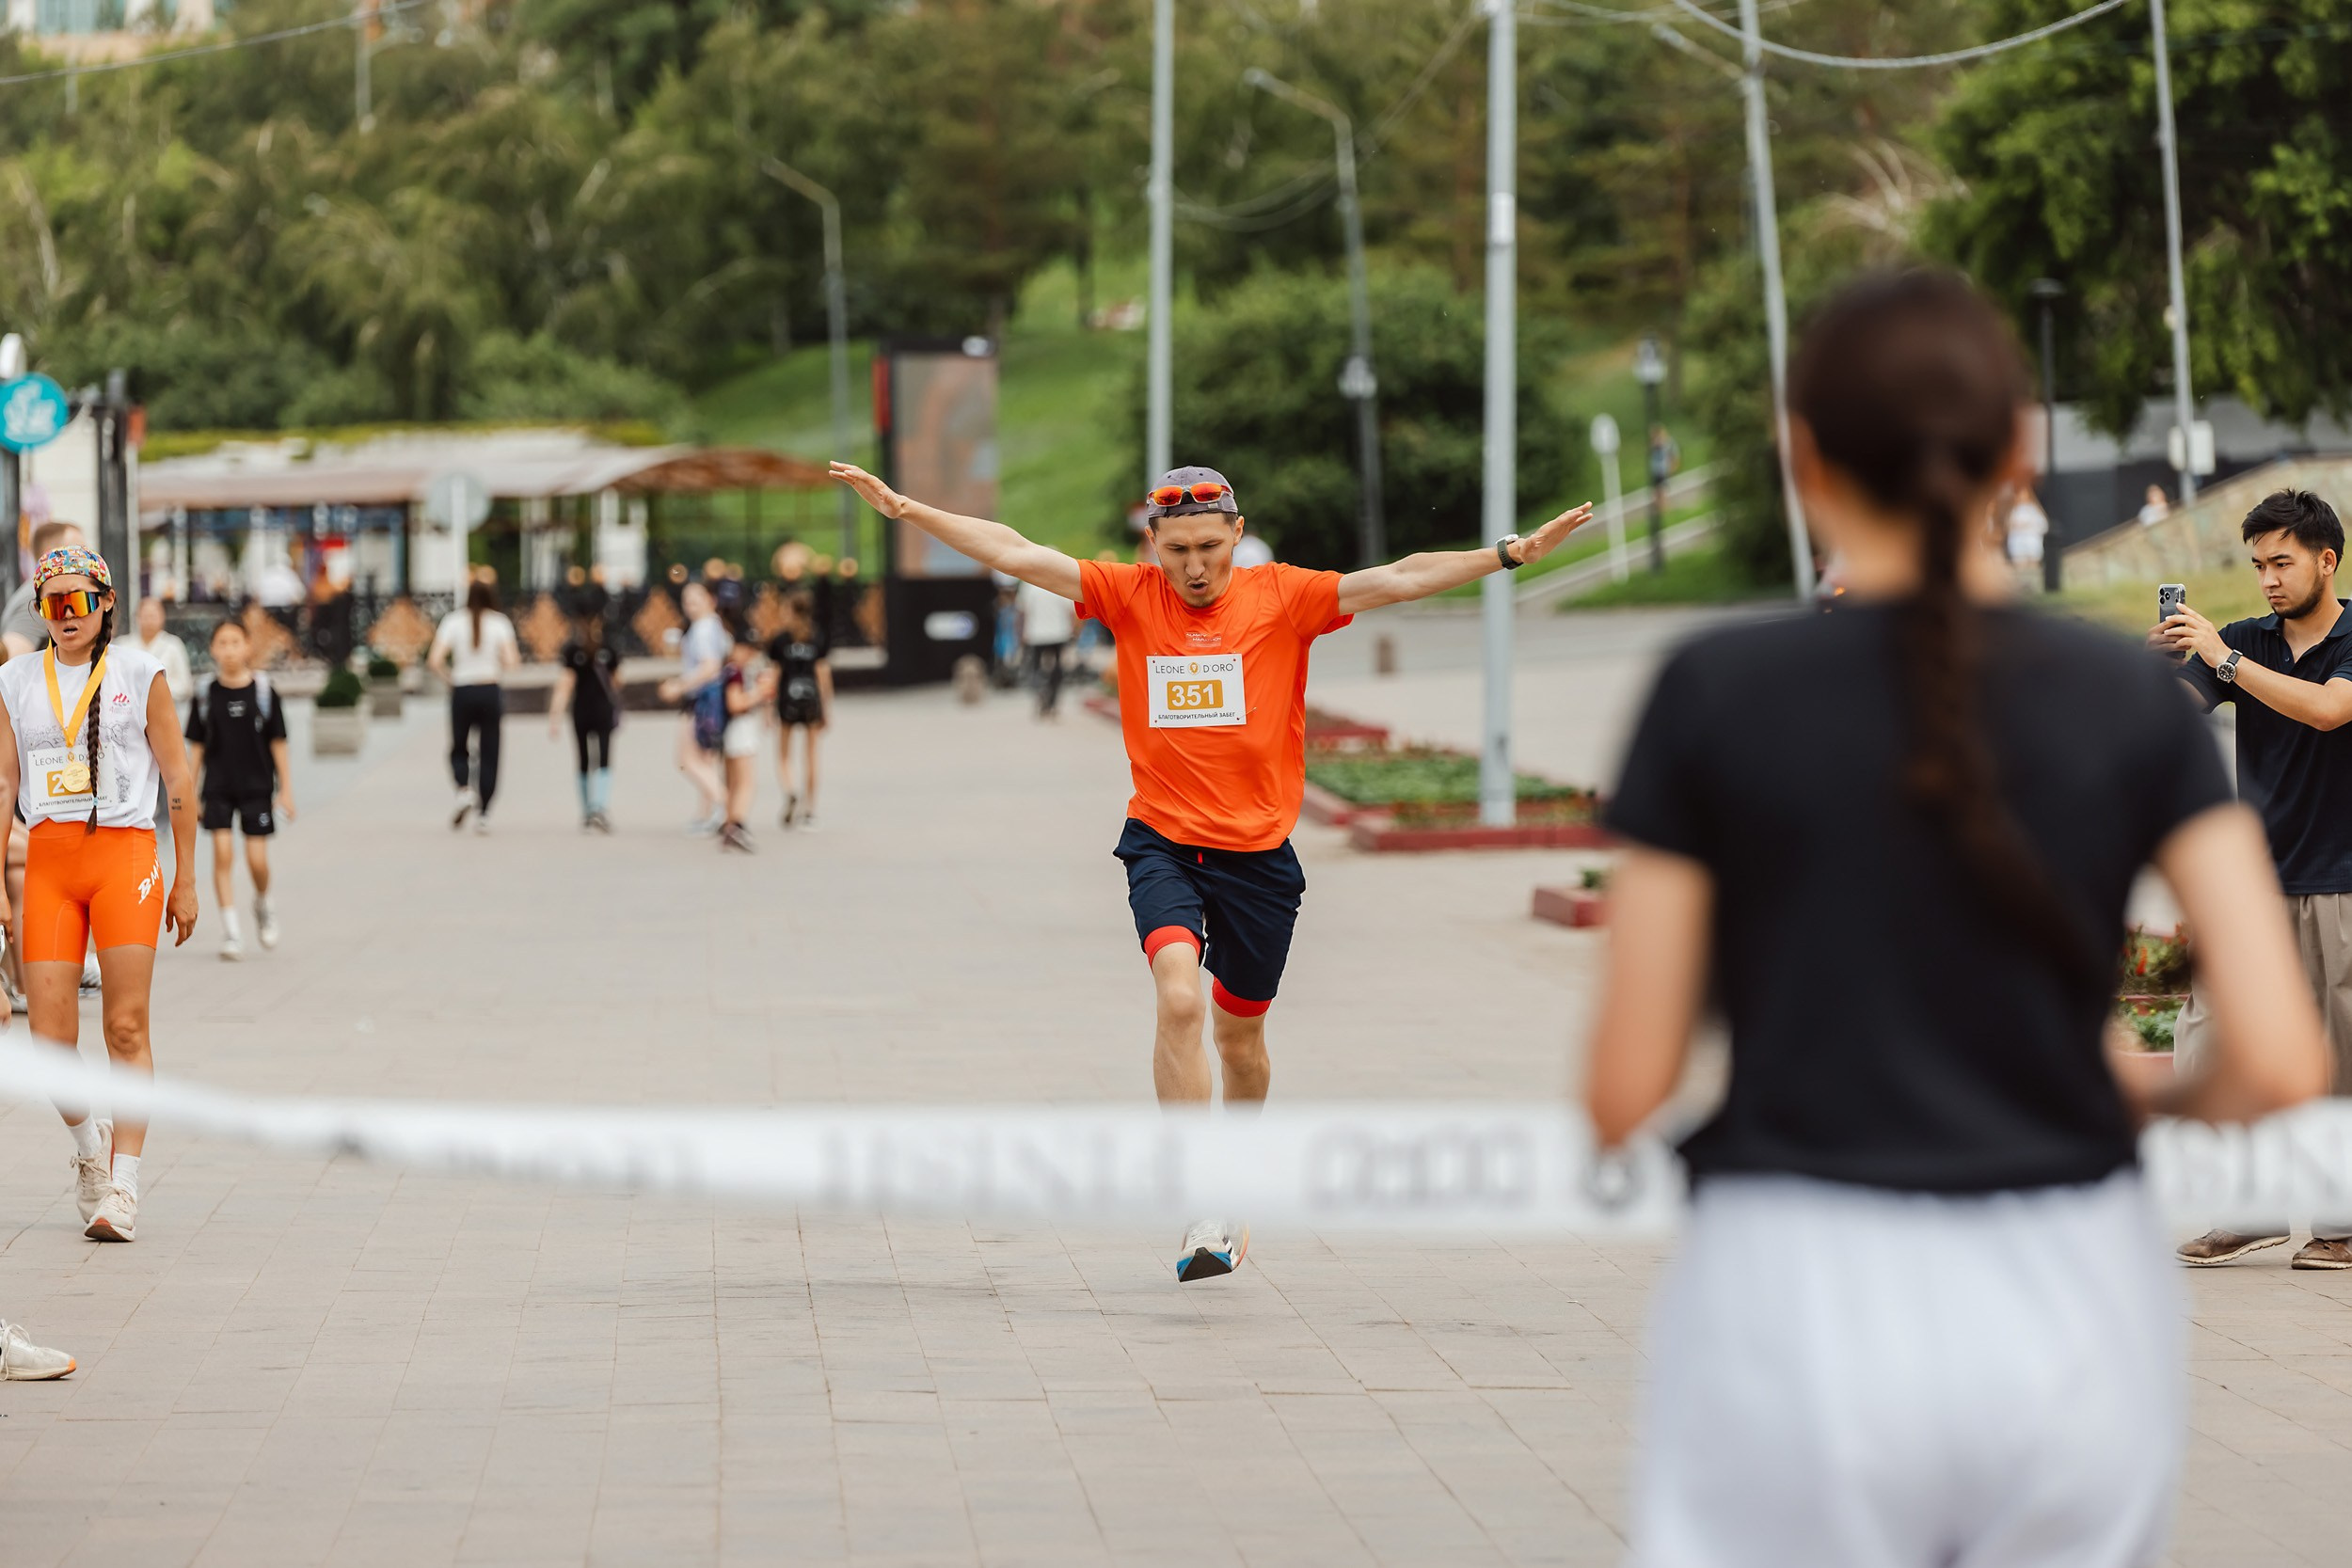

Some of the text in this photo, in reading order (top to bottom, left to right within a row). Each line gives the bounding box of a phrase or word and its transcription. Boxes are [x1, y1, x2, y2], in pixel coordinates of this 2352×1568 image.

[1155, 663, 1233, 674] LEONE D'ORO
[1171, 683, 1215, 707] 351
[35, 756, 64, 767] LEONE
